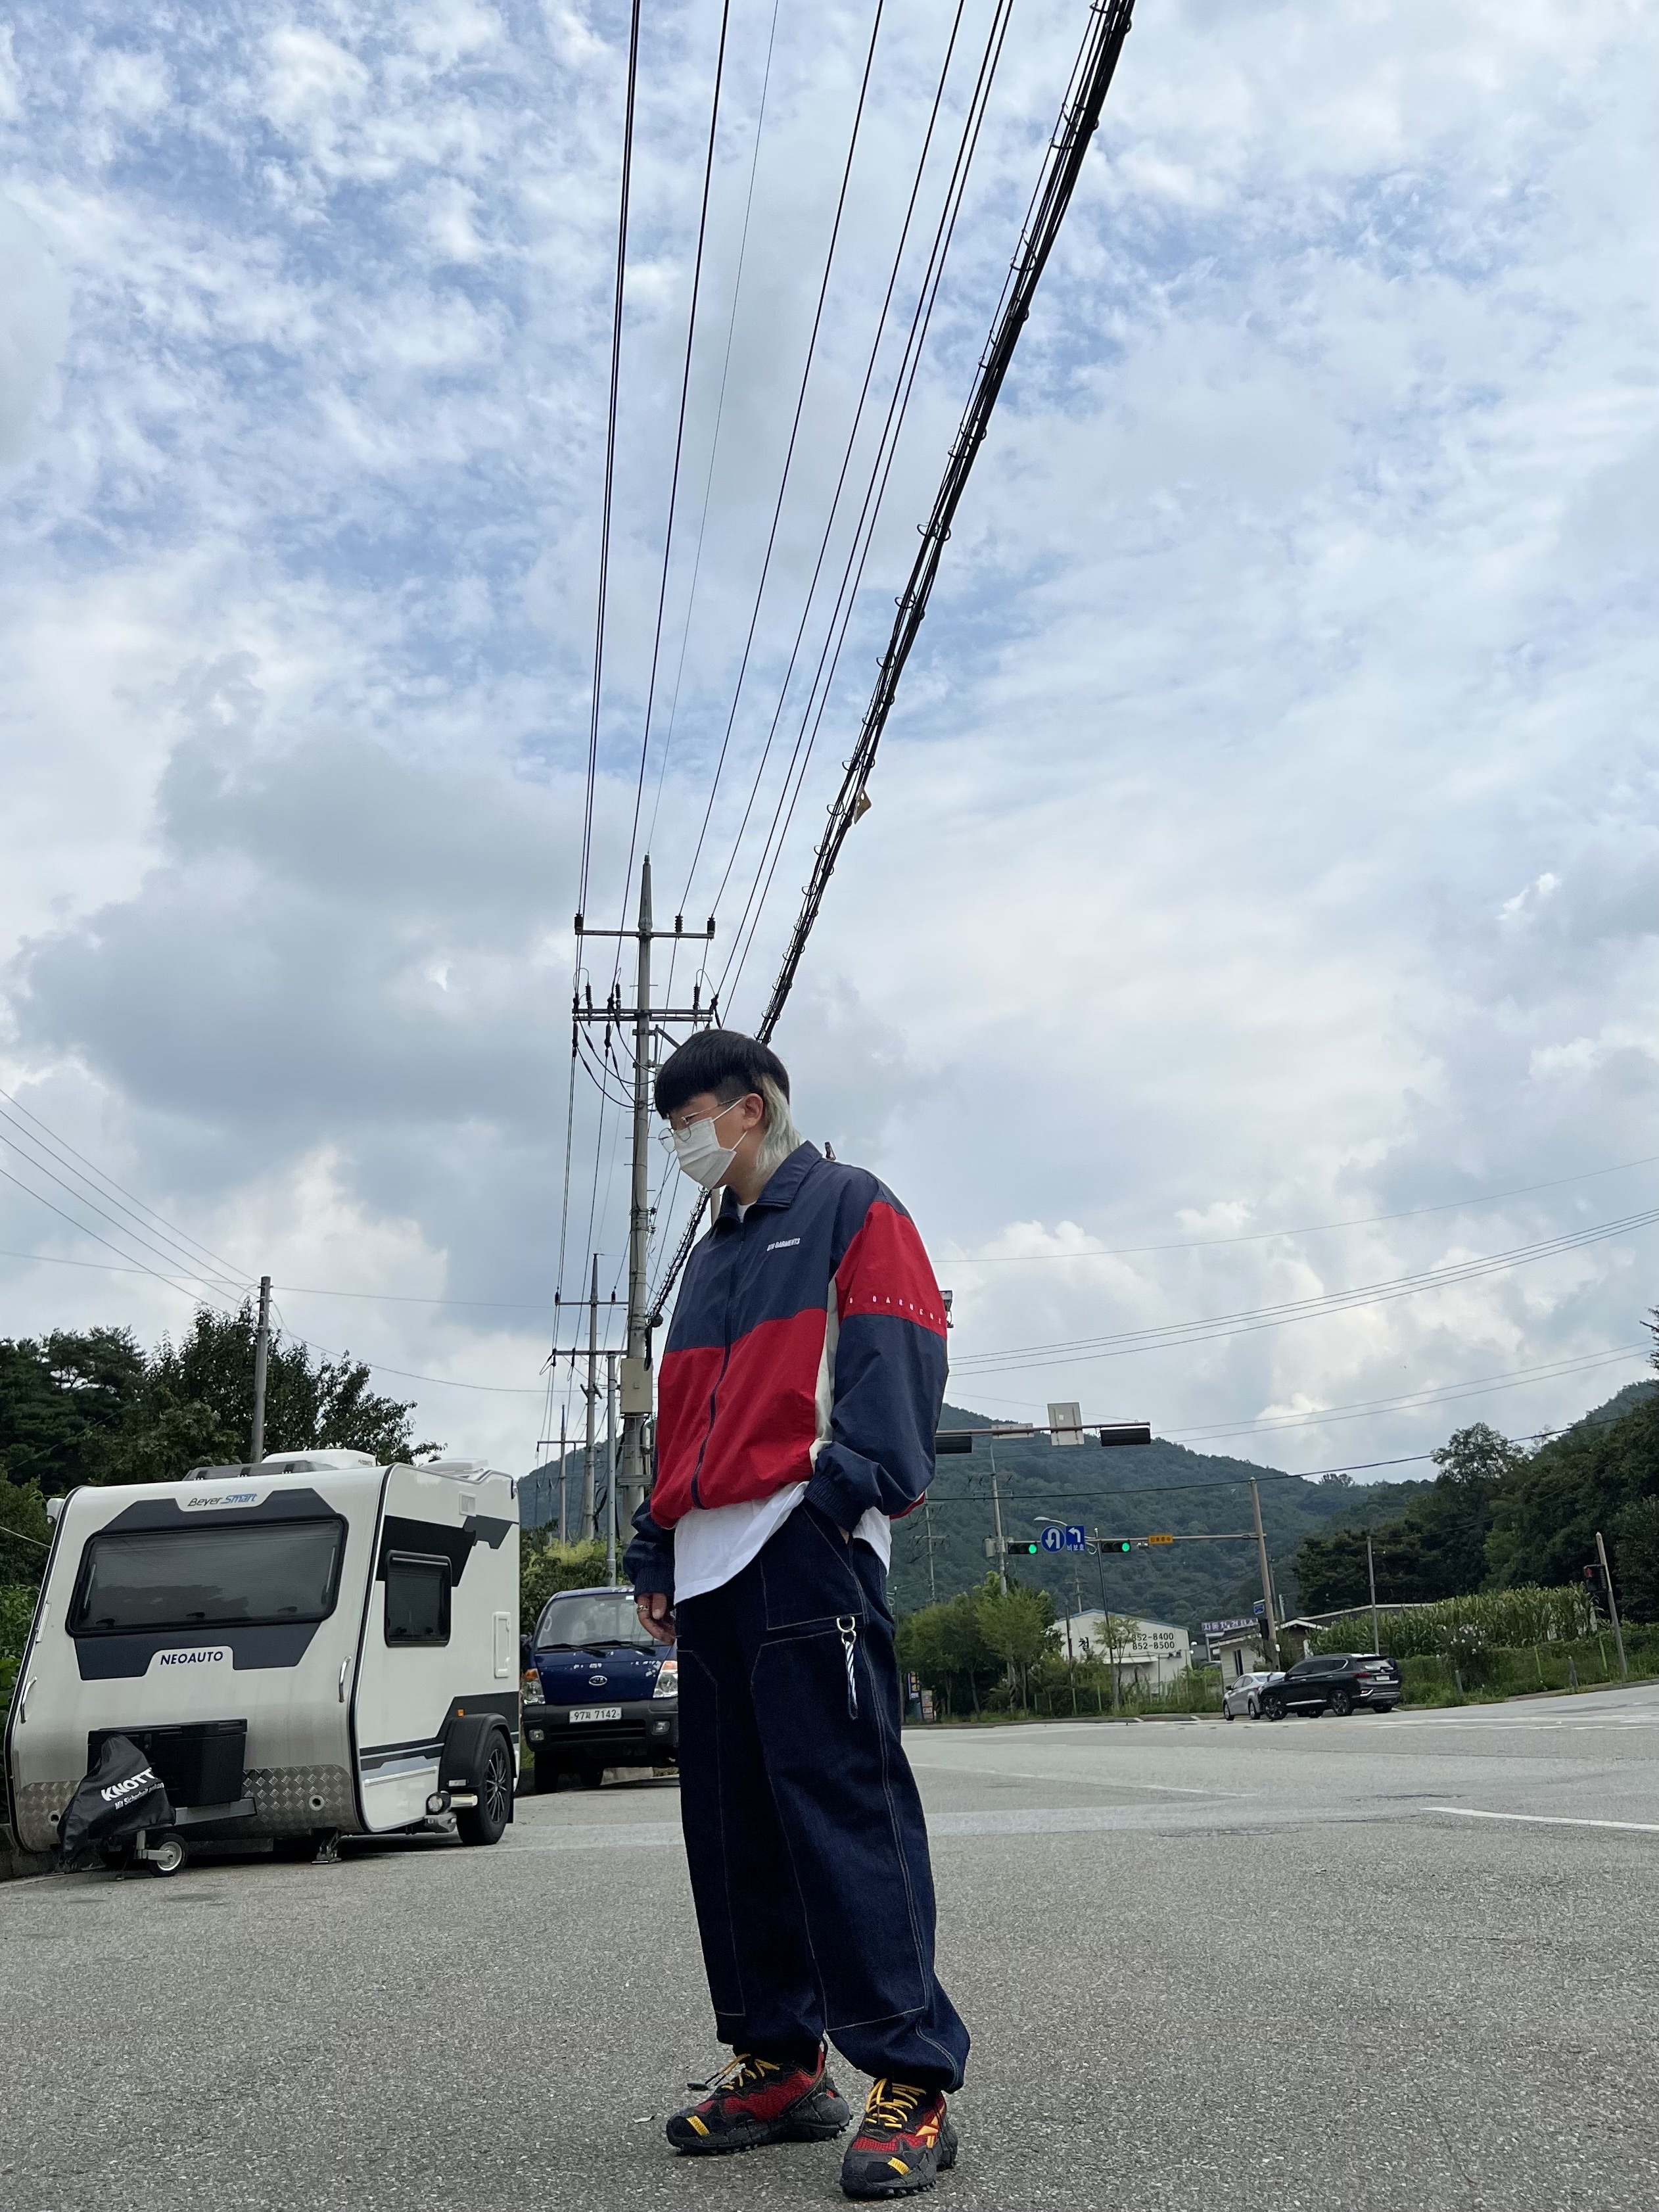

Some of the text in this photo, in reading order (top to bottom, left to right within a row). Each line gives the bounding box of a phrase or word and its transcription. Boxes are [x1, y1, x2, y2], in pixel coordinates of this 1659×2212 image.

[220, 1494, 258, 1504] Smart
[1131, 1632, 1174, 1641] 852-8400
[1133, 1641, 1175, 1650] 852-8500
[160, 1651, 223, 1665] NEOAUTO
[595, 1709, 617, 1719] 7142
[101, 1767, 156, 1801] KNOTT
